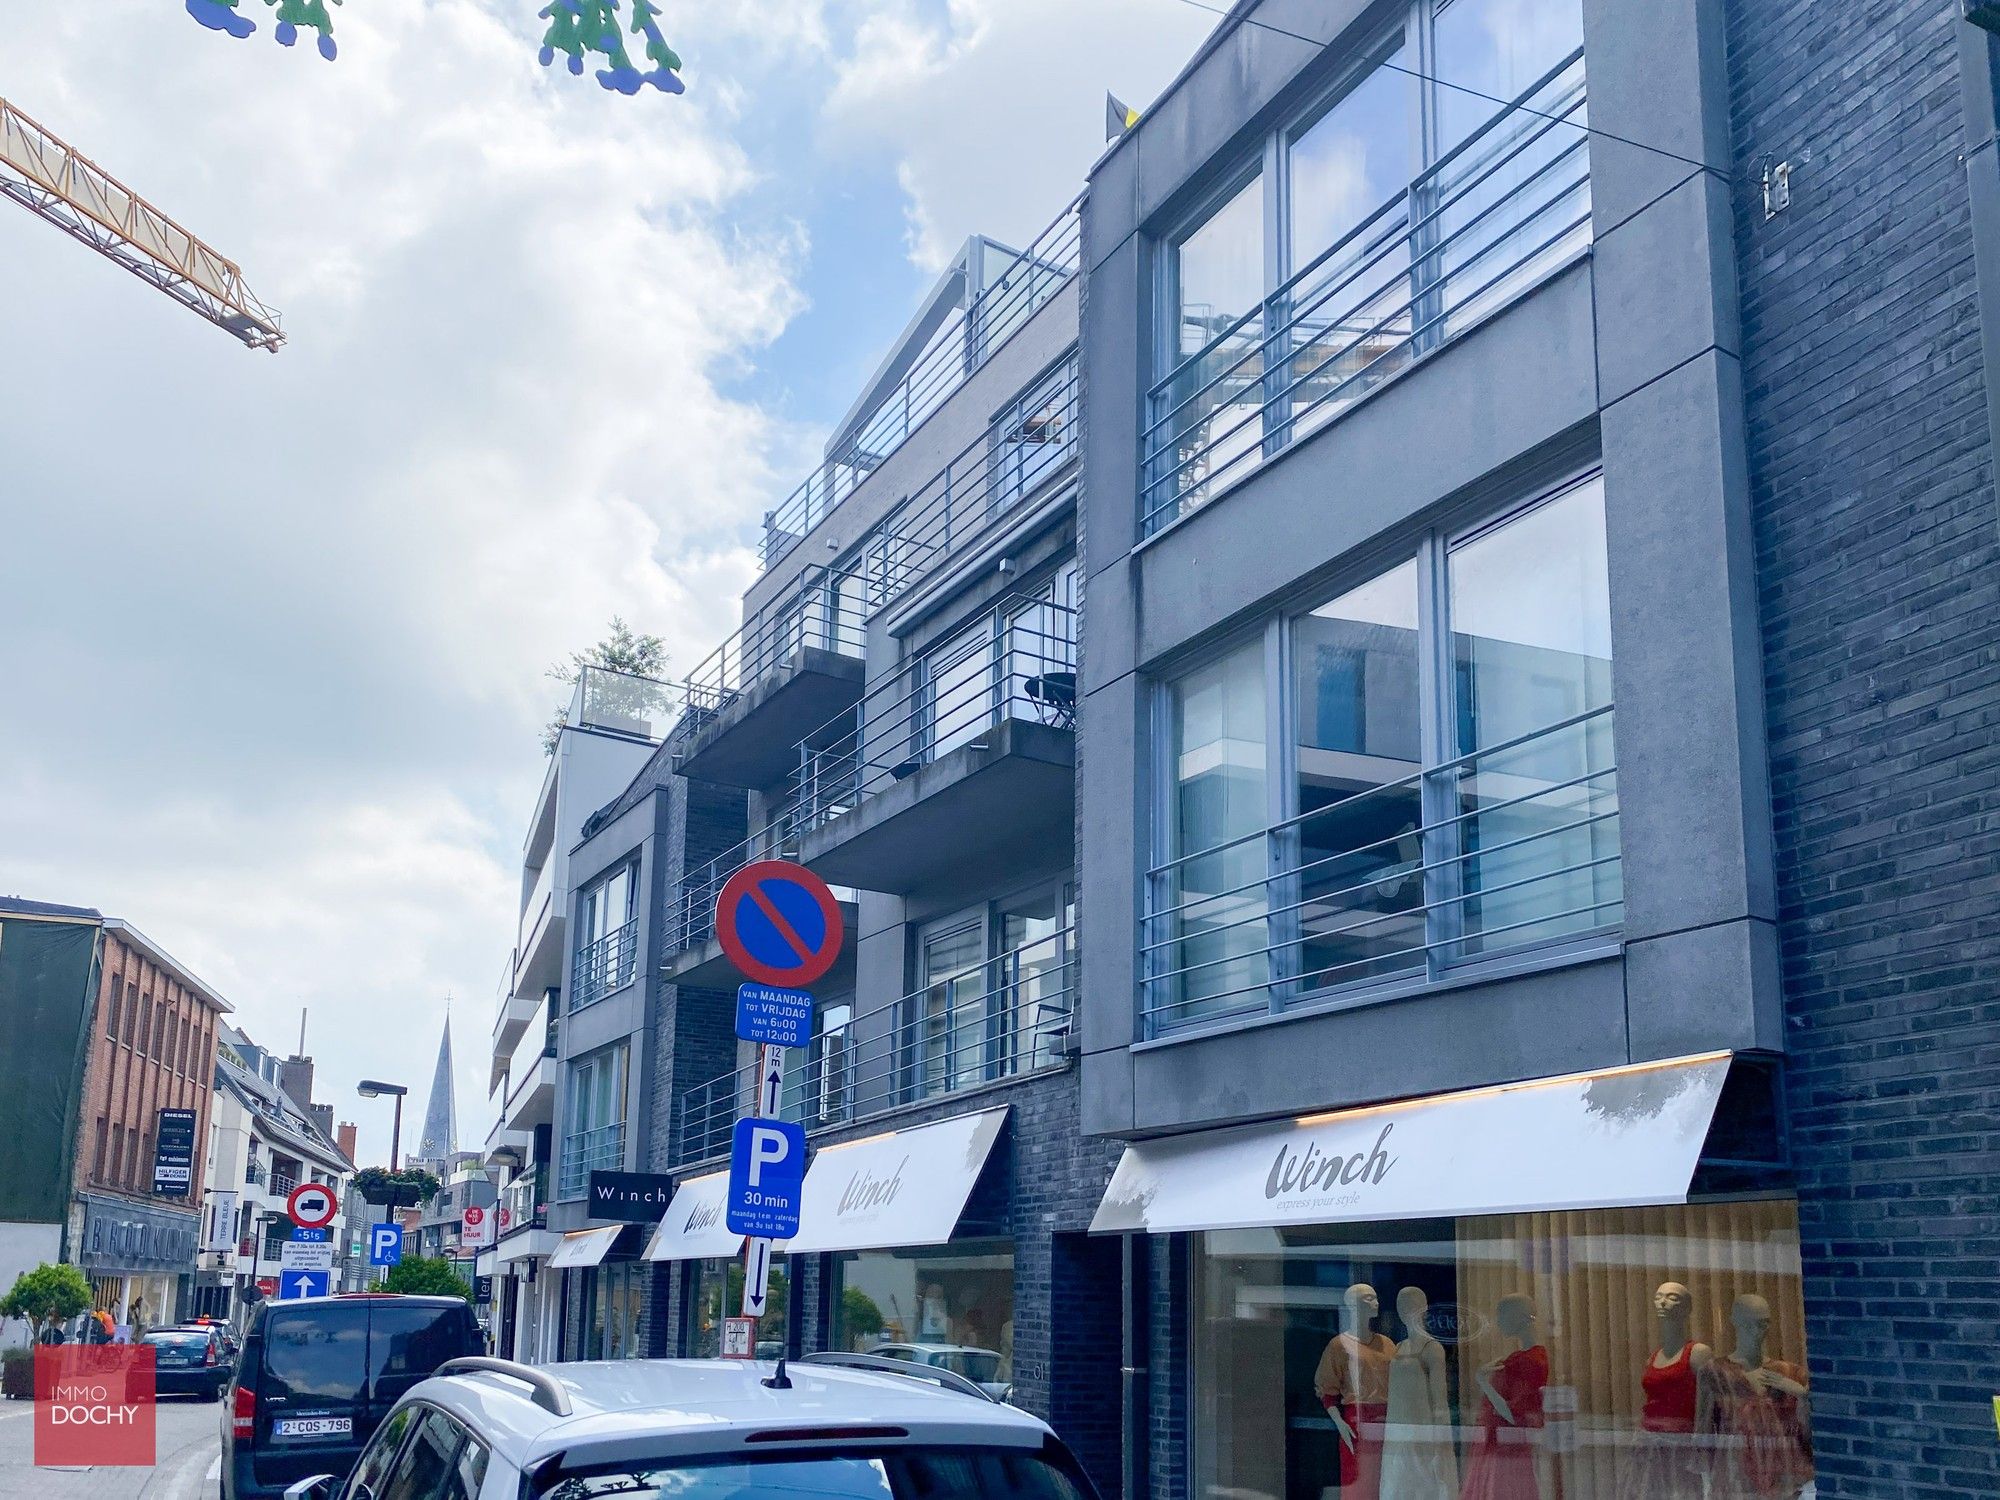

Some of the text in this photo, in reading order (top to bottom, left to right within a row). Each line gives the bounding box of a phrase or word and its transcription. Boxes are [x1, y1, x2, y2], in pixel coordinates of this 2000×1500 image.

[743, 991, 811, 1007] VAN MAANDAG
[746, 1003, 806, 1019] TOT VRIJDAG
[753, 1017, 767, 1026] VAN
[751, 1029, 764, 1037] TOT
[771, 1046, 781, 1058] 12
[771, 1058, 780, 1067] m
[749, 1127, 789, 1187] P
[1265, 1122, 1400, 1200] Winch
[597, 1185, 666, 1202] Winch
[837, 1154, 910, 1217] Winch
[744, 1191, 788, 1208] 30 min
[1277, 1191, 1360, 1212] express your style
[731, 1210, 756, 1219] maandag
[375, 1230, 398, 1259] P
